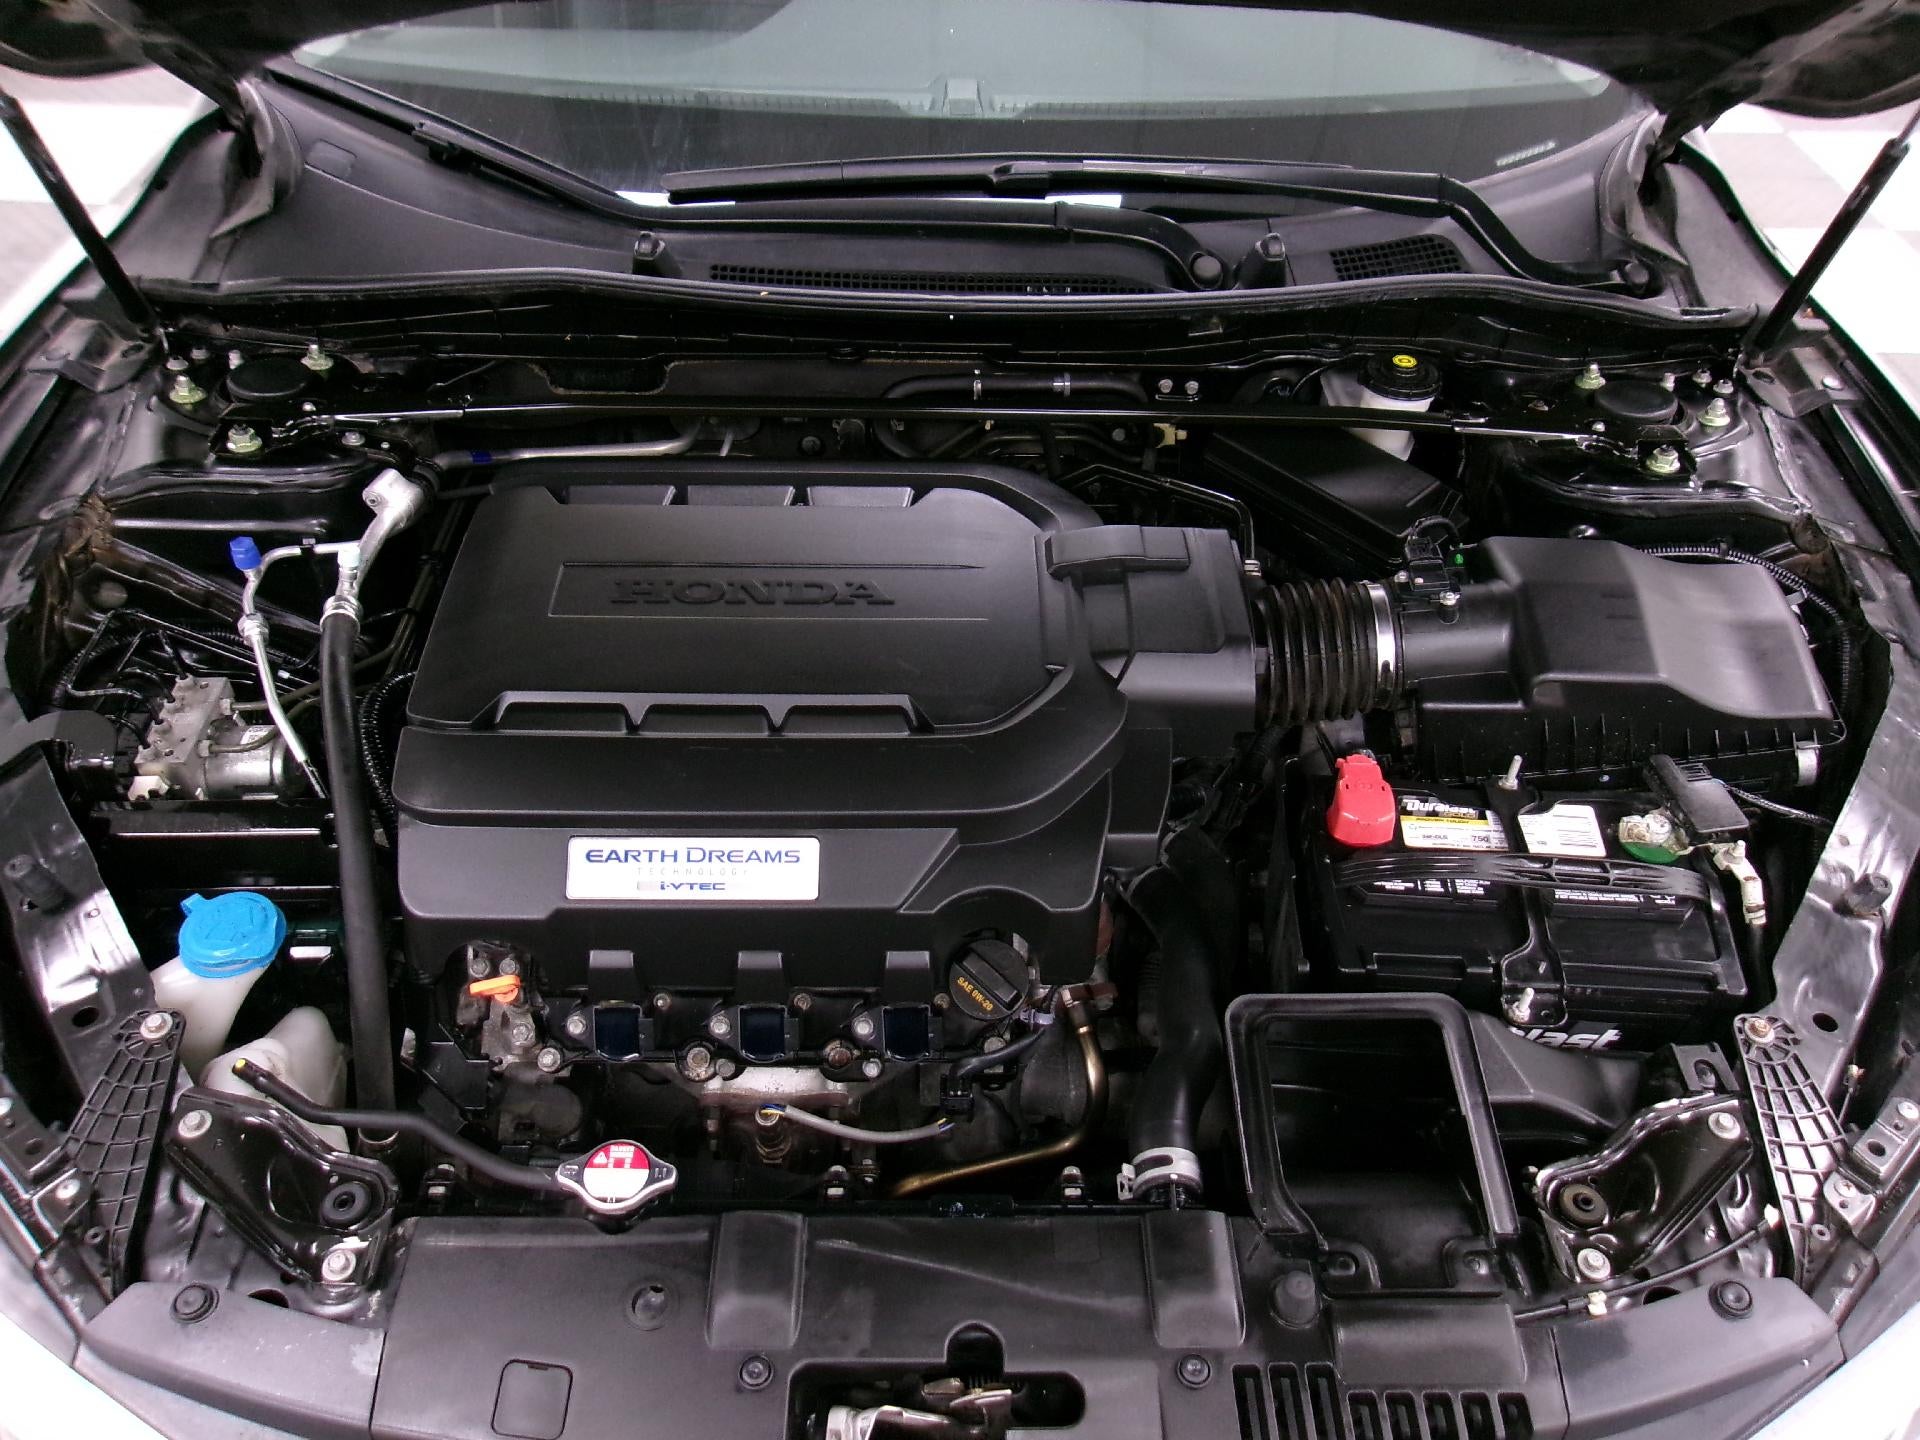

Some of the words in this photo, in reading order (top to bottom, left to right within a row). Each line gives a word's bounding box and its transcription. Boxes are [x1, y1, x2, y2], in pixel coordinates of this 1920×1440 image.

[610, 579, 896, 606] HONDA
[585, 849, 679, 863] EARTH
[686, 847, 801, 863] DREAMS
[957, 976, 974, 993] SAE
[1508, 1026, 1622, 1050] last
